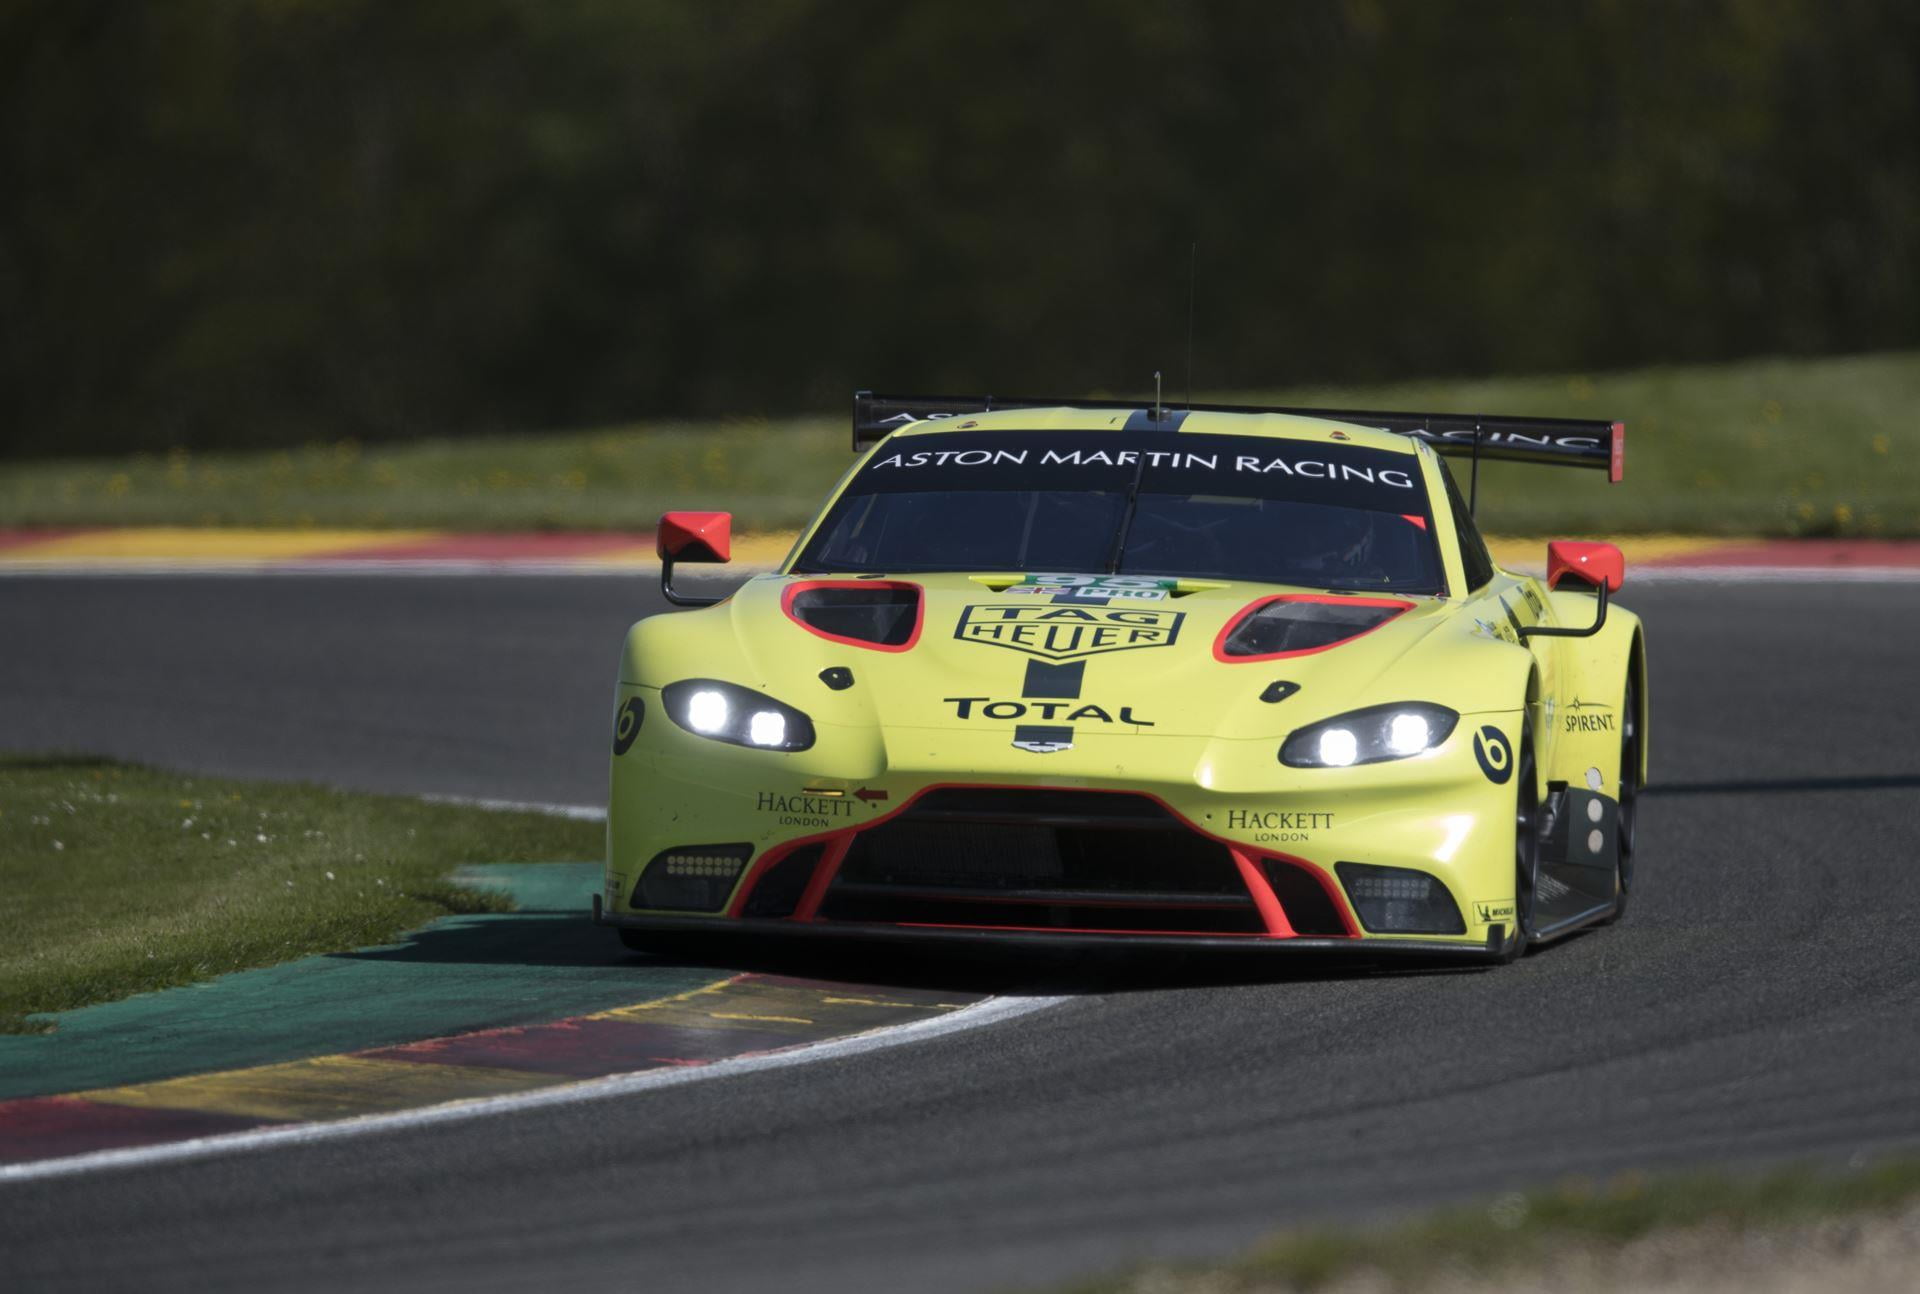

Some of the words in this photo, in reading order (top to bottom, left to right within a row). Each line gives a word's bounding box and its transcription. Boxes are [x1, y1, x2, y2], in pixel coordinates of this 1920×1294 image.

[873, 450, 1028, 469] ASTON
[1040, 450, 1218, 470] MARTIN
[1236, 456, 1414, 489] RACING
[1034, 574, 1159, 588] 95
[1081, 587, 1160, 599] PRO
[985, 607, 1160, 625] TAG
[971, 624, 1161, 652] HEUER
[943, 697, 1155, 727] TOTAL
[1565, 713, 1616, 732] SPIRENT
[756, 791, 855, 817] HACKETT
[778, 815, 830, 828] LONDON
[1227, 809, 1335, 830] HACKETT
[1254, 832, 1310, 842] LONDON
